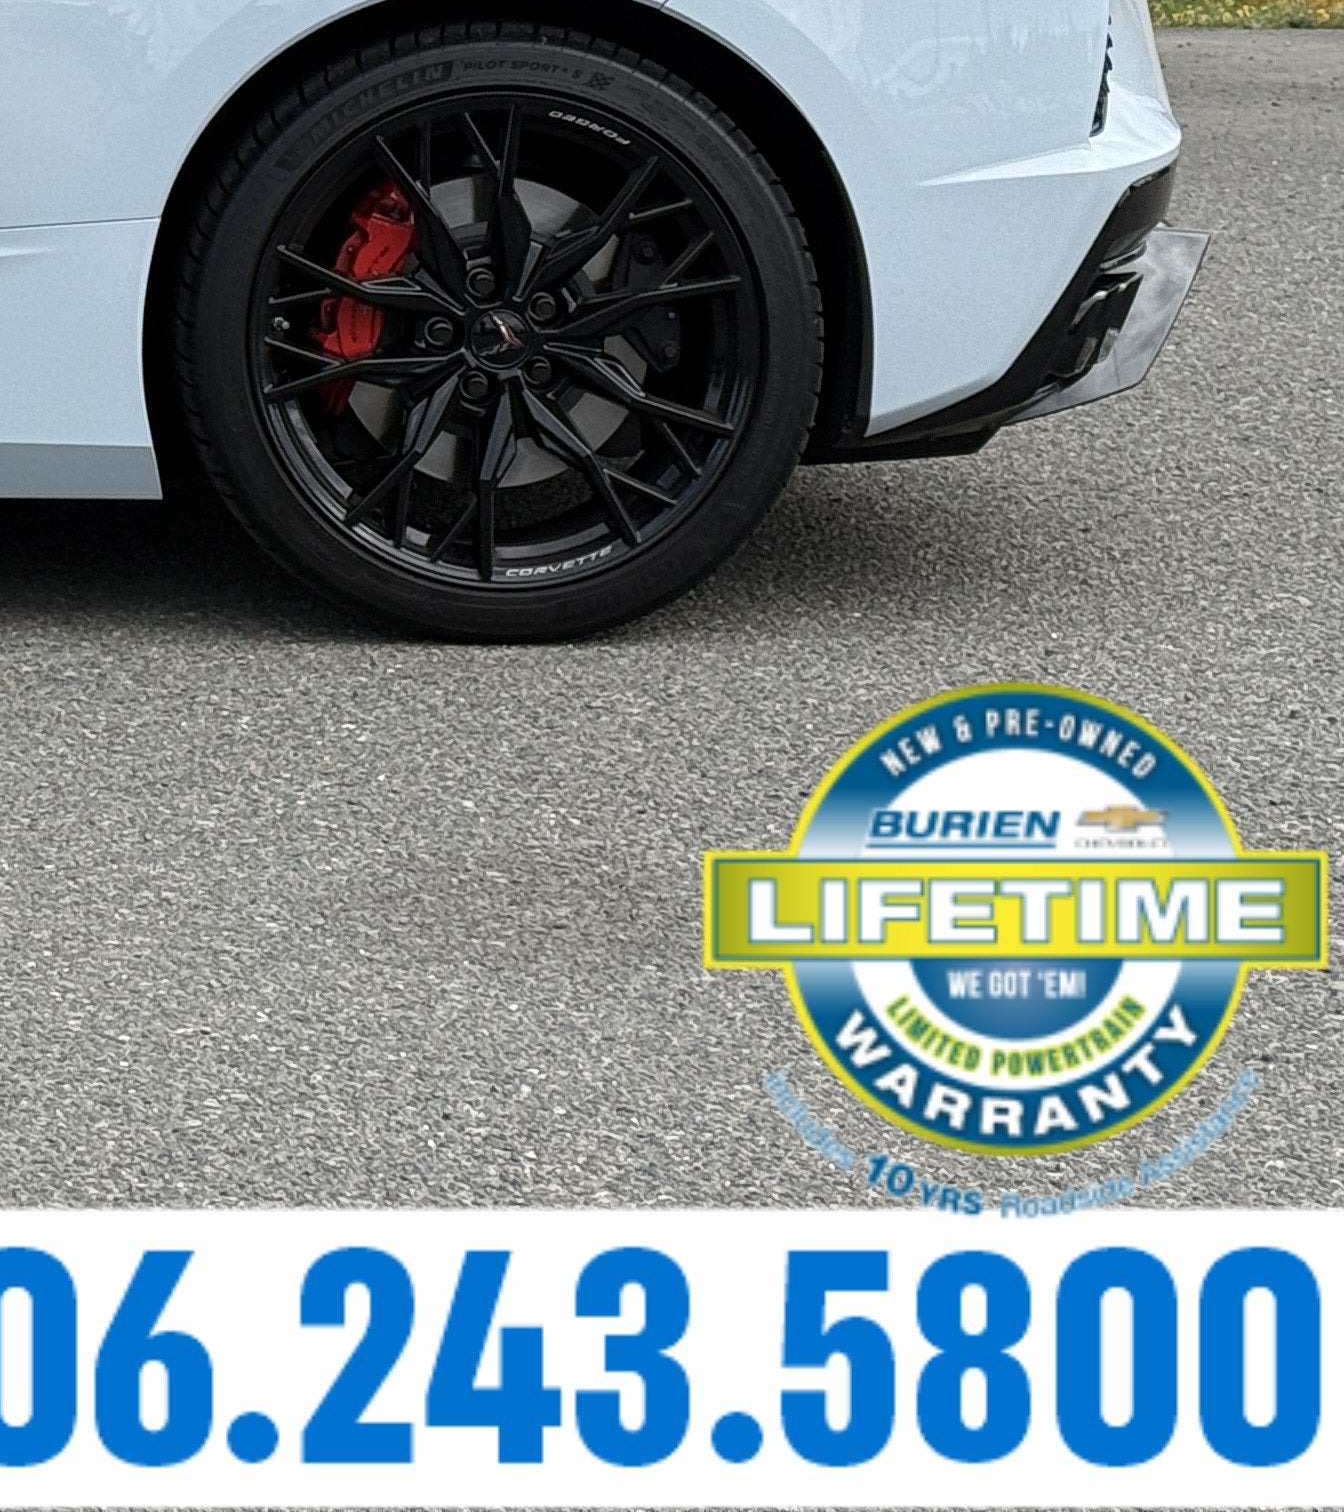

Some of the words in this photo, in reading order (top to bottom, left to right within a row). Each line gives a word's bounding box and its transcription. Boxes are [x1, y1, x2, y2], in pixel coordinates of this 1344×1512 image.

[312, 65, 443, 144] MICHELIN
[462, 59, 504, 71] PILOT
[510, 59, 560, 74] SPORT
[548, 110, 632, 145] FORGED
[505, 545, 612, 577] CORVETTE
